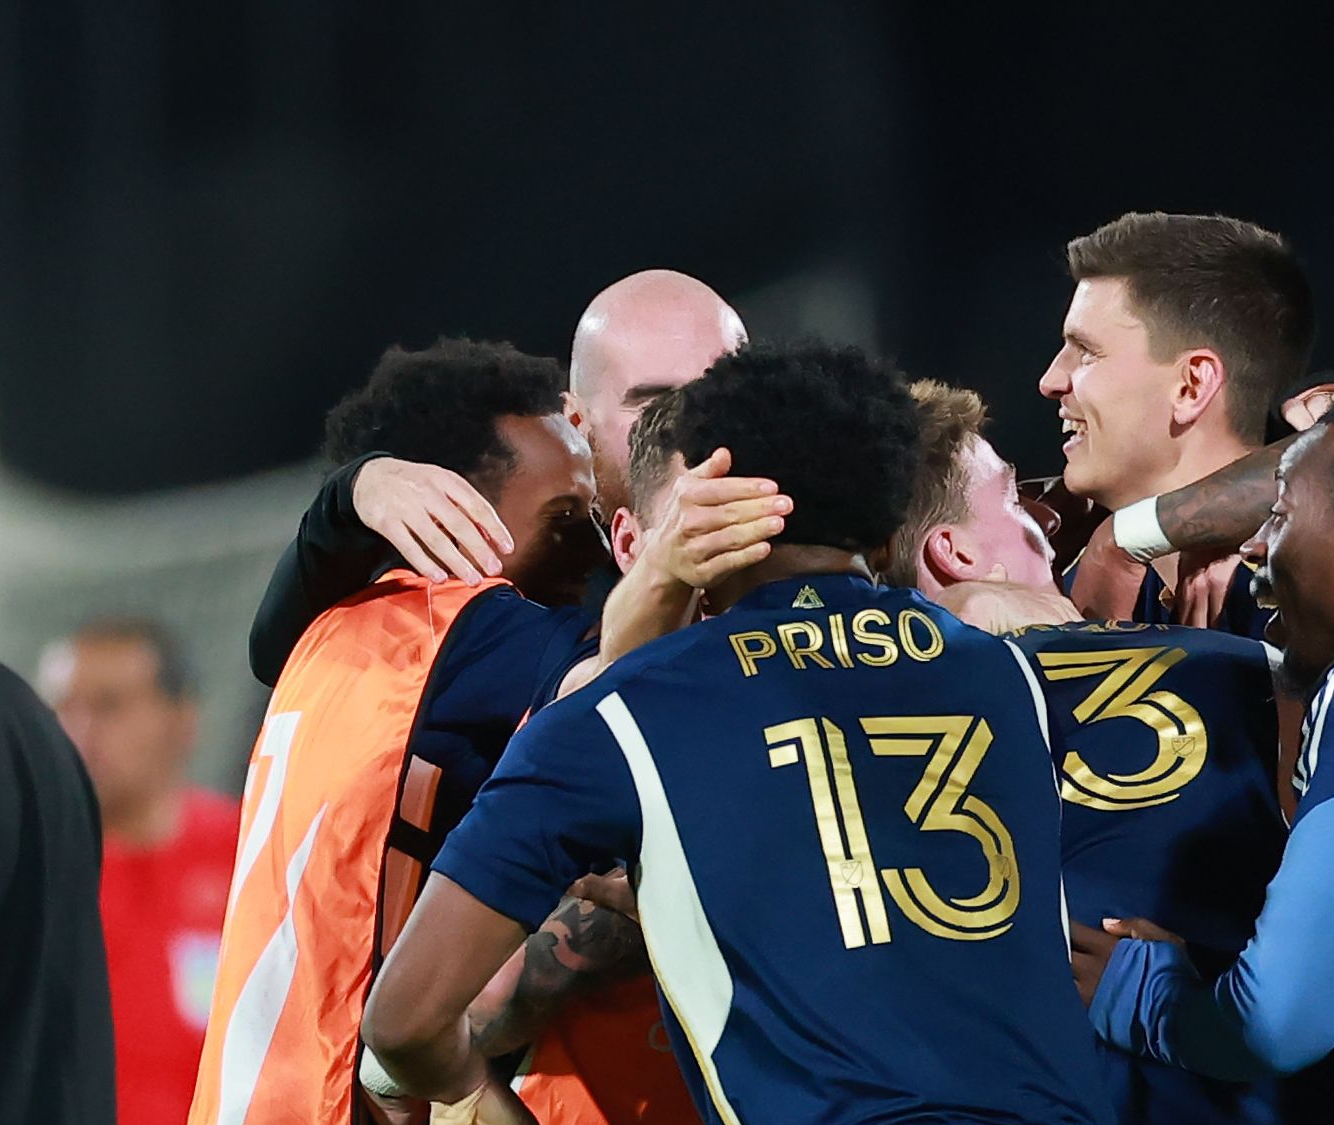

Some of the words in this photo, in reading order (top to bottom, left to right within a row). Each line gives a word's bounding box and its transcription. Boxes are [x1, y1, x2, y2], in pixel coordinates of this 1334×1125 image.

[727, 607, 945, 678] PRISO
[1034, 645, 1209, 811] 3
[763, 715, 1021, 950] 13
